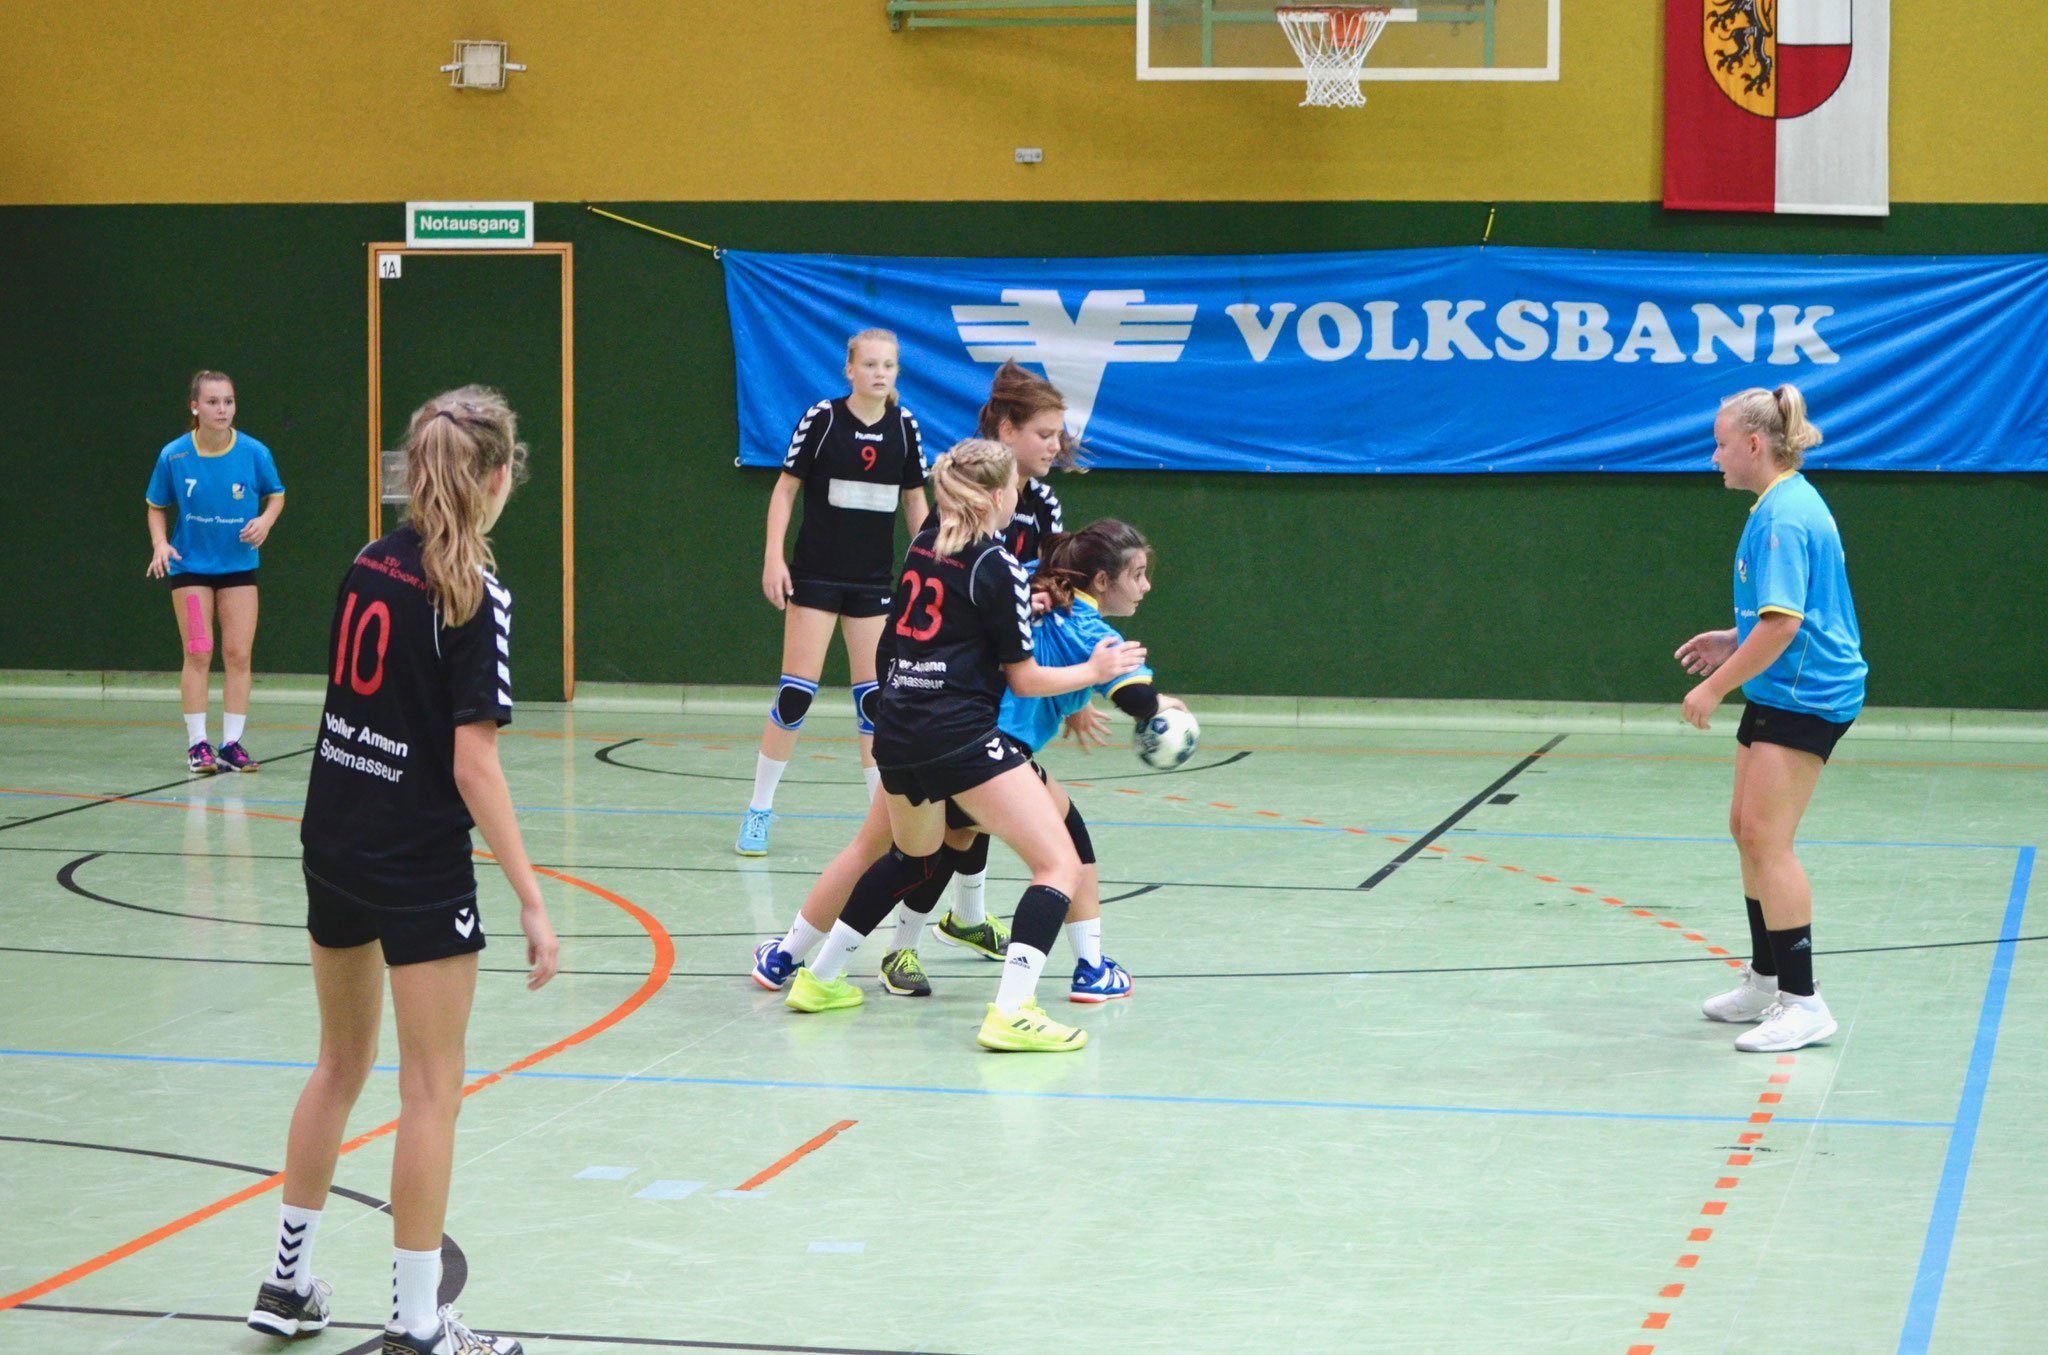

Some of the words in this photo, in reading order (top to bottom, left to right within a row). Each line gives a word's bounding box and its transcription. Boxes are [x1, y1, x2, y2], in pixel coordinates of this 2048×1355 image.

[420, 216, 519, 233] Notausgang
[382, 261, 397, 277] 1A
[1225, 300, 1840, 366] VOLKSBANK
[861, 445, 877, 471] 9
[185, 478, 197, 497] 7
[896, 570, 945, 642] 23
[334, 591, 390, 696] 10
[357, 726, 408, 758] Amann
